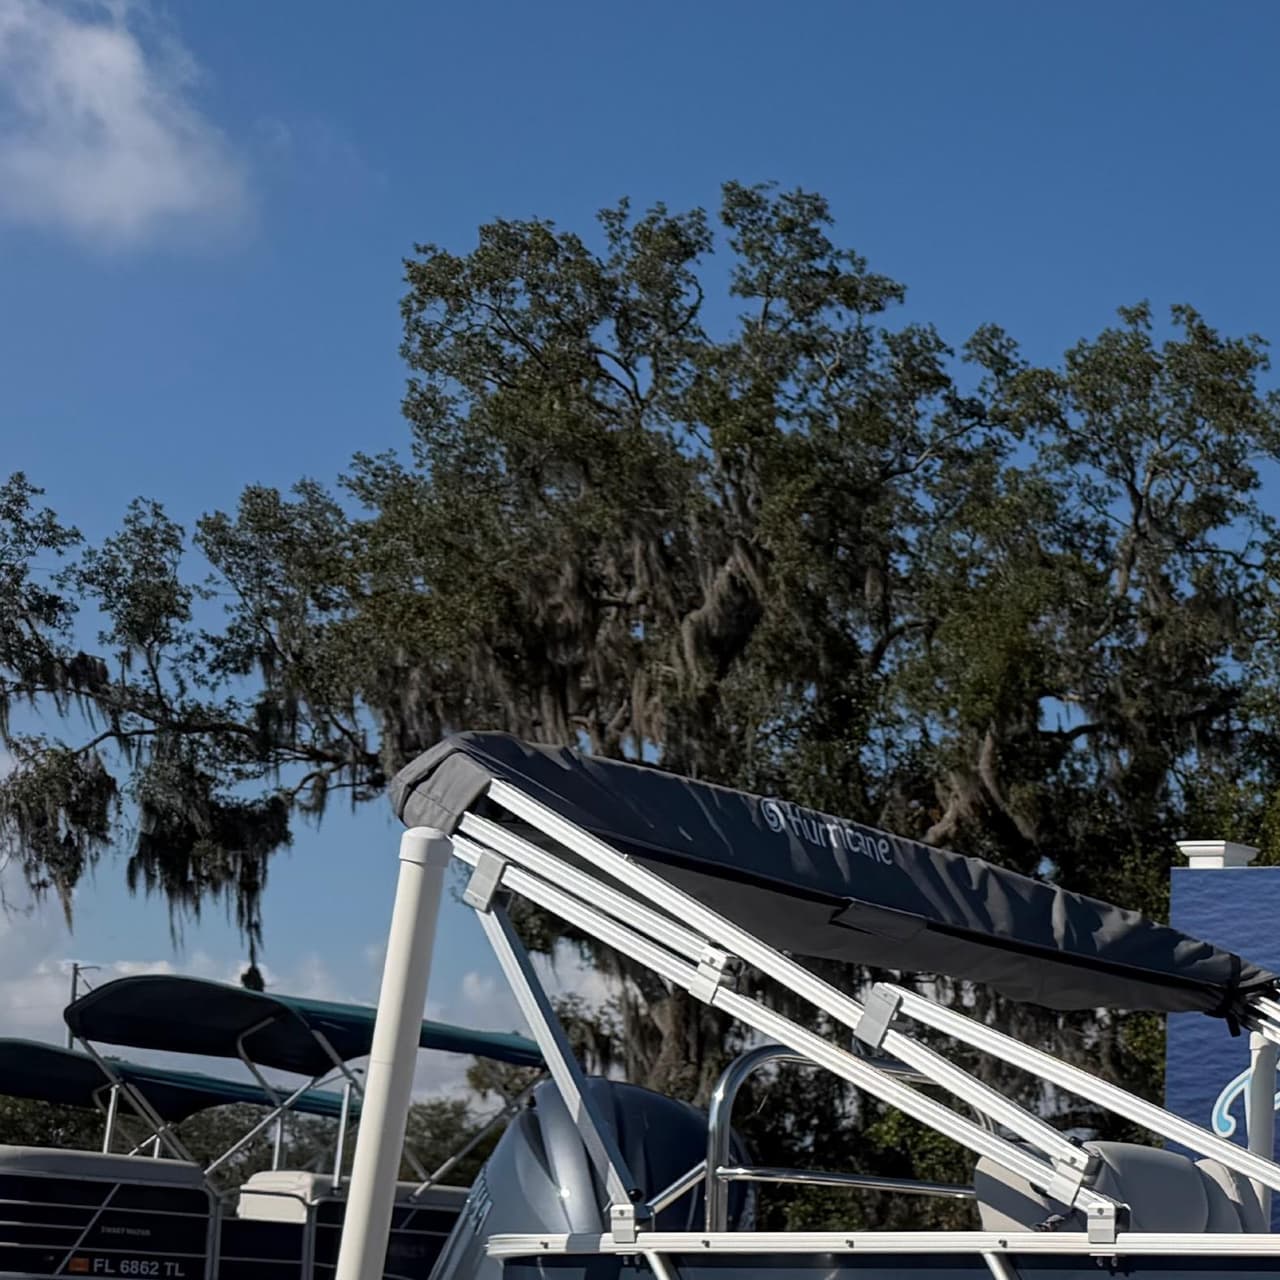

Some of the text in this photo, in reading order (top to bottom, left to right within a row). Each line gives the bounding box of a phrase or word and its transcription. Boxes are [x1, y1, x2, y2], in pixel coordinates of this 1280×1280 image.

[783, 801, 893, 866] Hurricane
[93, 1258, 186, 1277] FL 6862 TL
